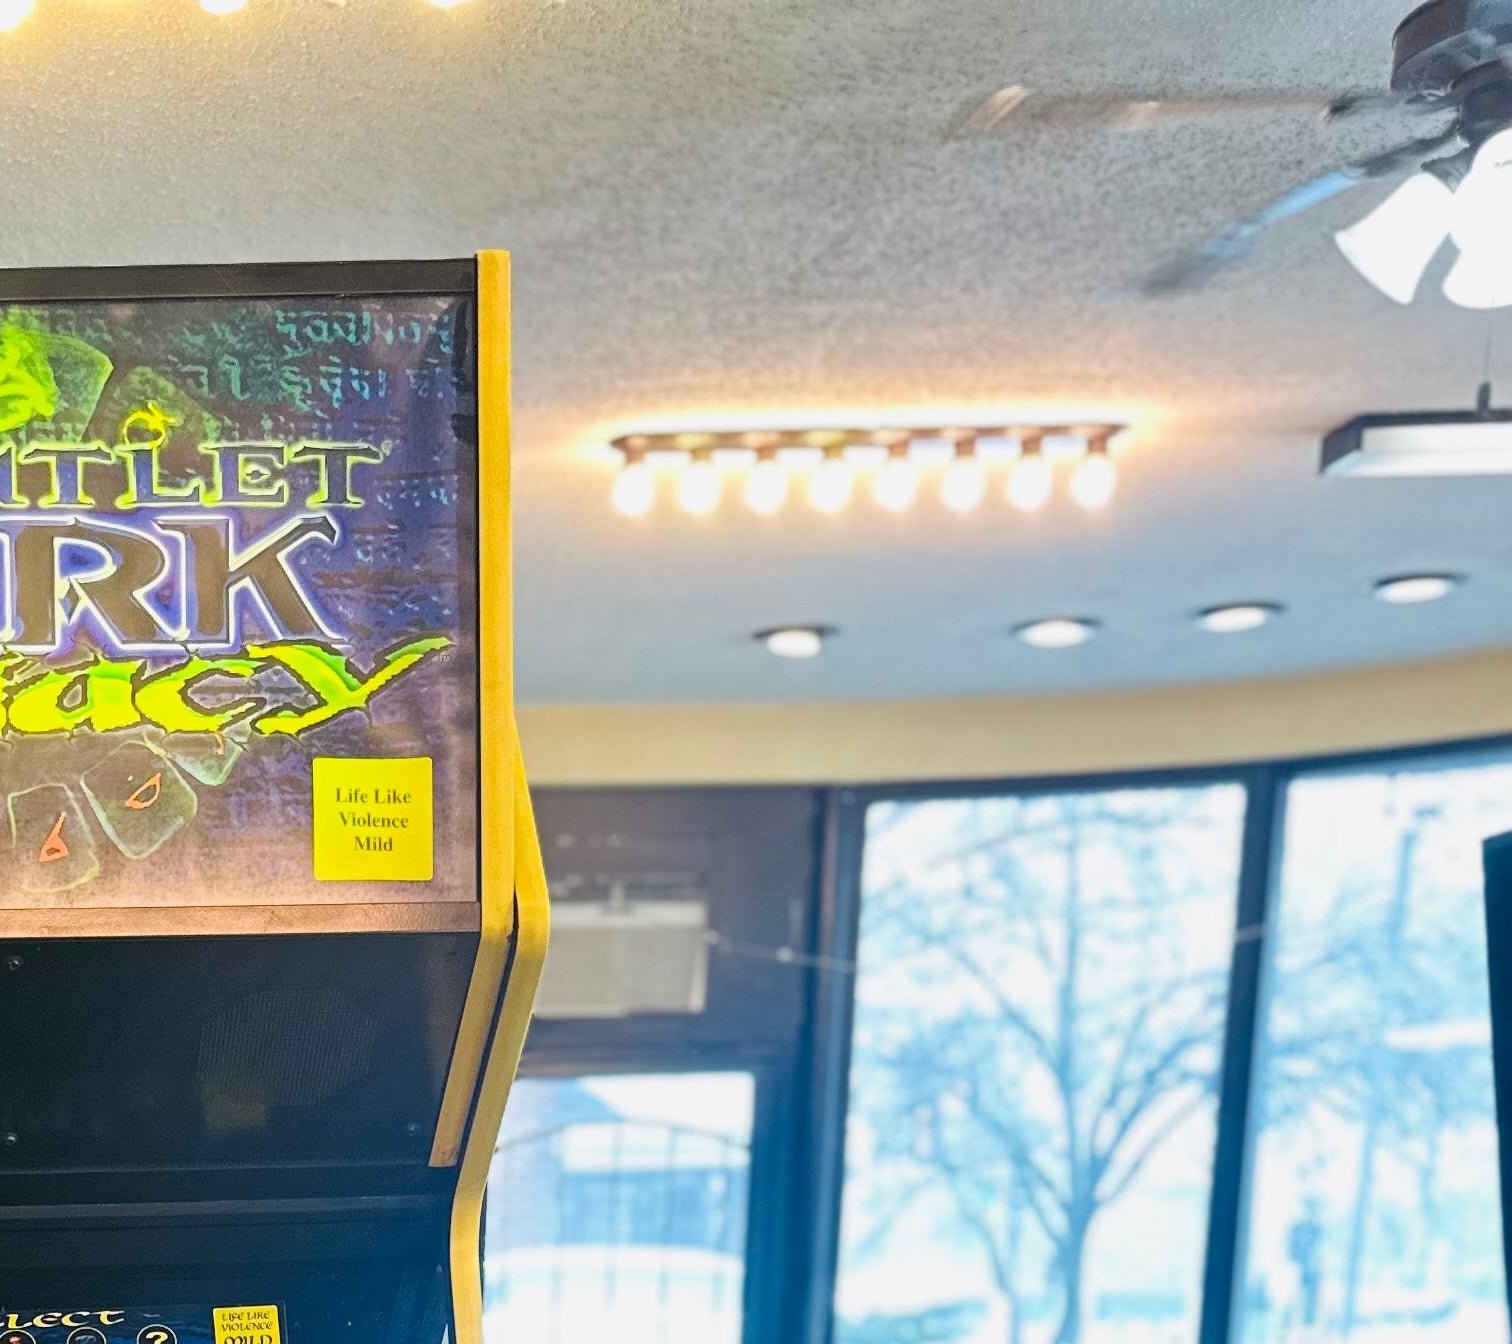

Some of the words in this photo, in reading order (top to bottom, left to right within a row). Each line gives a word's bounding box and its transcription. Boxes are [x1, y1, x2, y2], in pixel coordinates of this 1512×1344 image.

[336, 788, 368, 803] Life
[374, 789, 412, 804] Like
[339, 812, 409, 828] Violence
[354, 836, 393, 852] Mild
[221, 1312, 244, 1321] LIFE
[247, 1311, 271, 1320] LIKE
[221, 1322, 272, 1331] VIOLENCE
